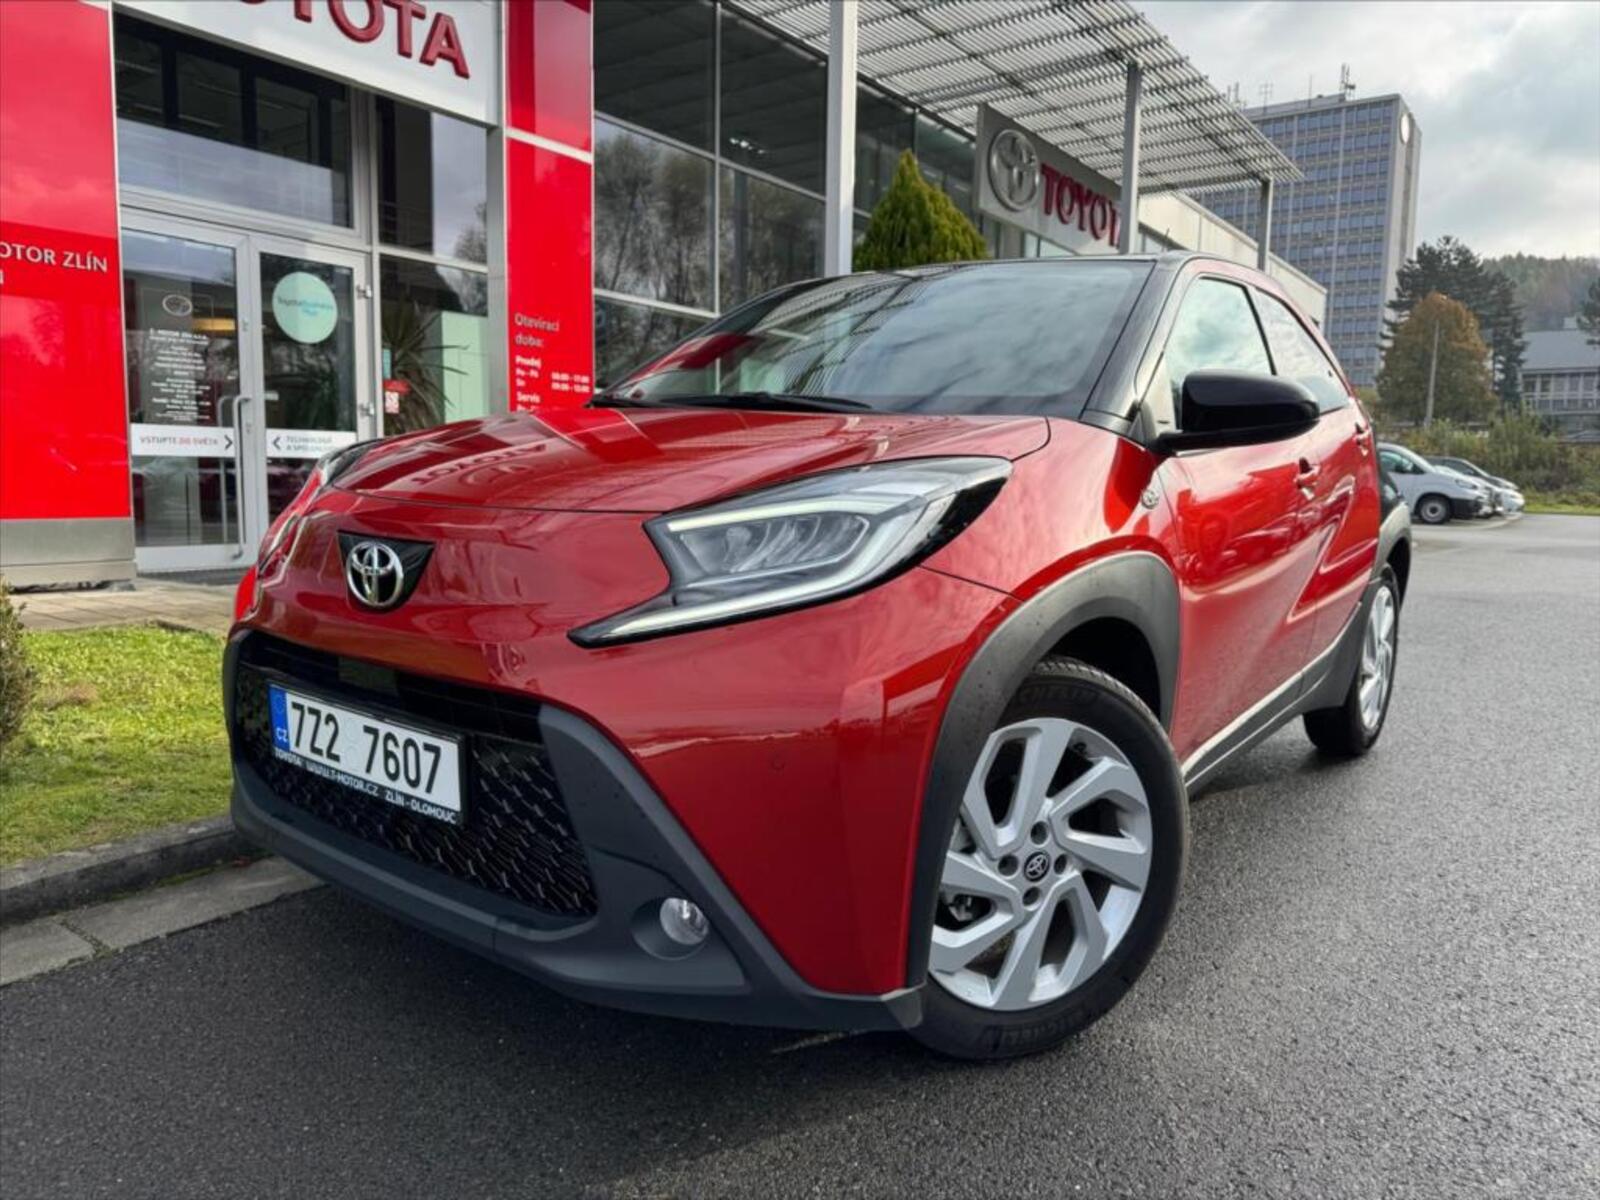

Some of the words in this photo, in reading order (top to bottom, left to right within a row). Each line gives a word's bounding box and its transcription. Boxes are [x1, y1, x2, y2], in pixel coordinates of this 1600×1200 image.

[243, 0, 470, 79] OTA
[1041, 163, 1120, 249] TOYOT
[62, 250, 108, 273] ZLÍN
[515, 355, 542, 369] Prodej
[517, 391, 541, 403] Servis
[276, 727, 288, 742] CZ
[291, 701, 341, 763] 7Z2
[363, 724, 442, 794] 7607
[411, 798, 457, 825] OLOMOUC
